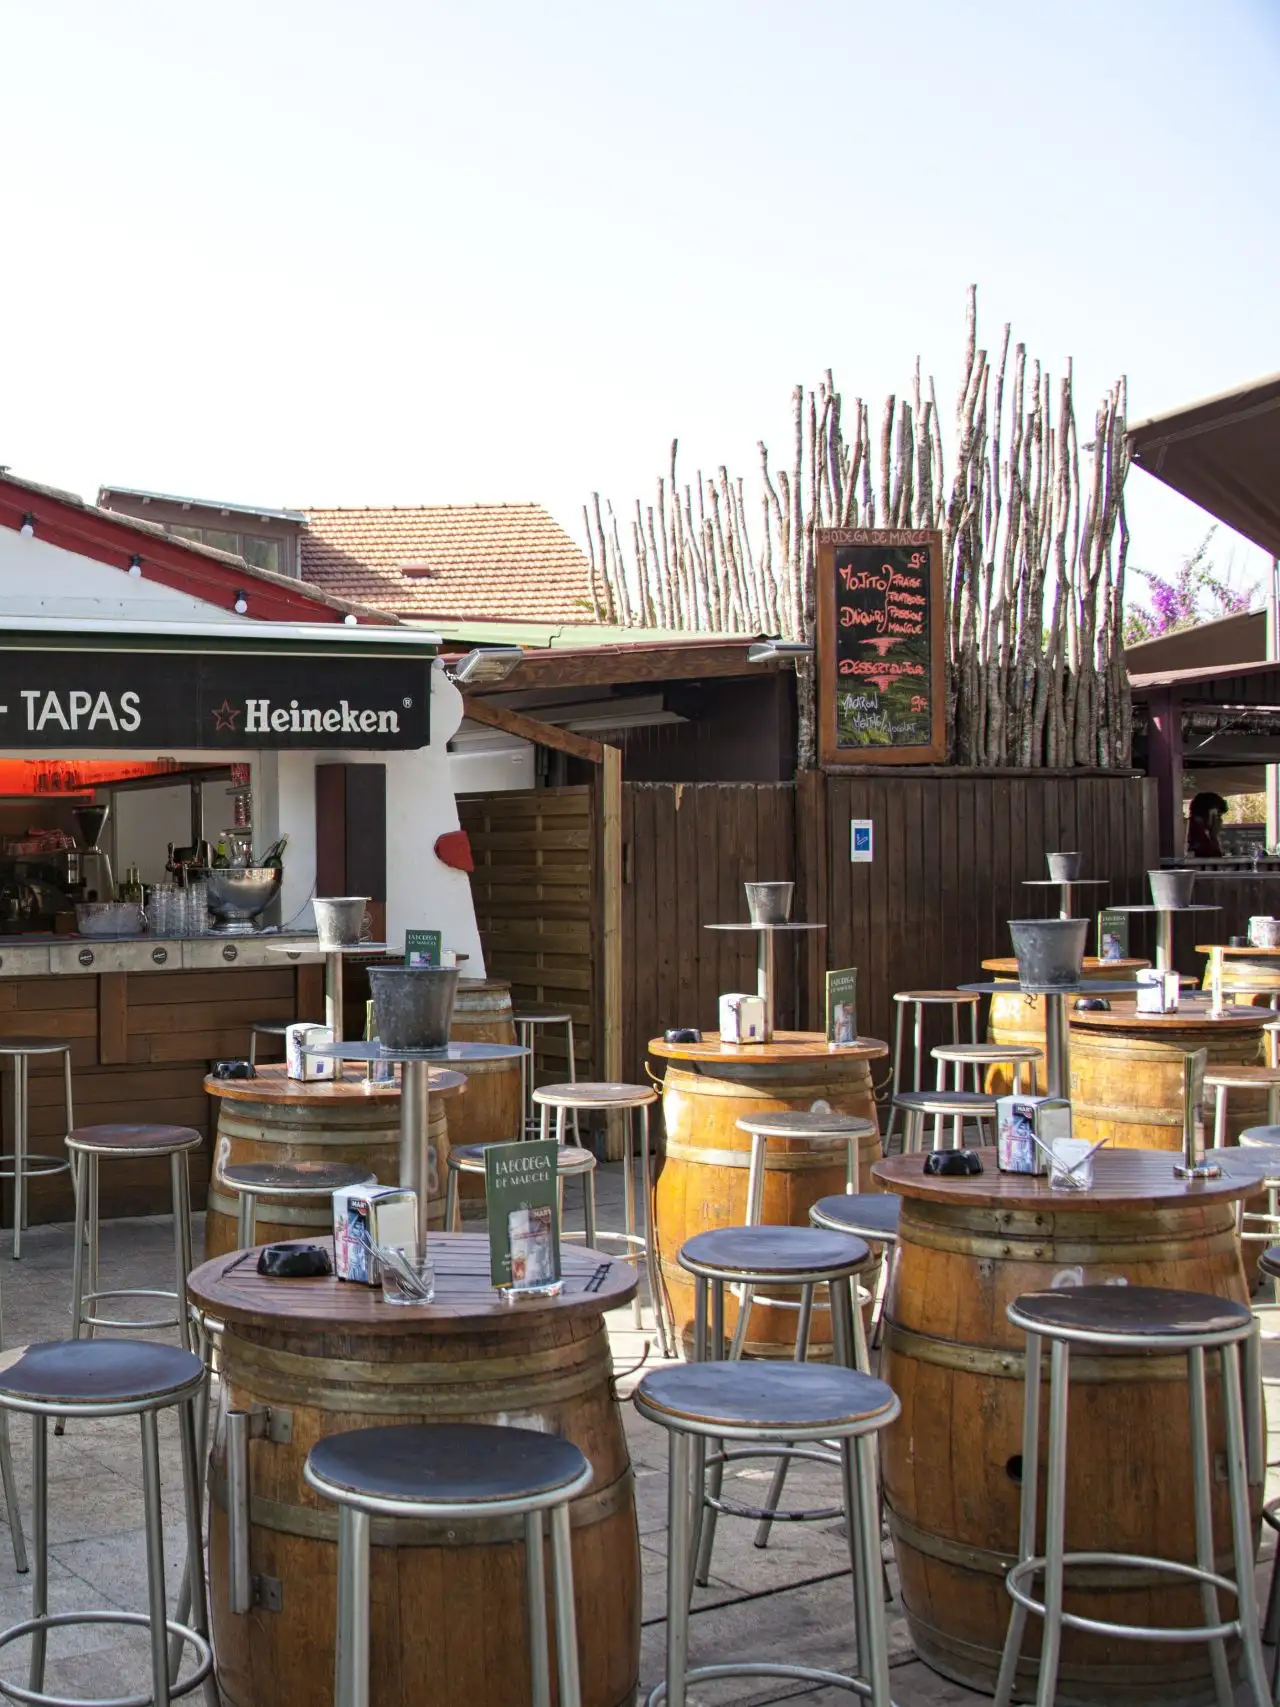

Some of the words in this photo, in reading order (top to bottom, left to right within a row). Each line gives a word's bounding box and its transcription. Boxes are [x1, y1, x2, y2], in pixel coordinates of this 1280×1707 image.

[872, 532, 887, 544] DE
[890, 530, 934, 545] MARCEL
[21, 690, 141, 732] TAPAS
[244, 699, 400, 734] Heineken
[495, 1160, 508, 1176] LA
[509, 1154, 552, 1173] BODEGA
[495, 1177, 508, 1188] DE
[510, 1171, 551, 1185] MARCEL
